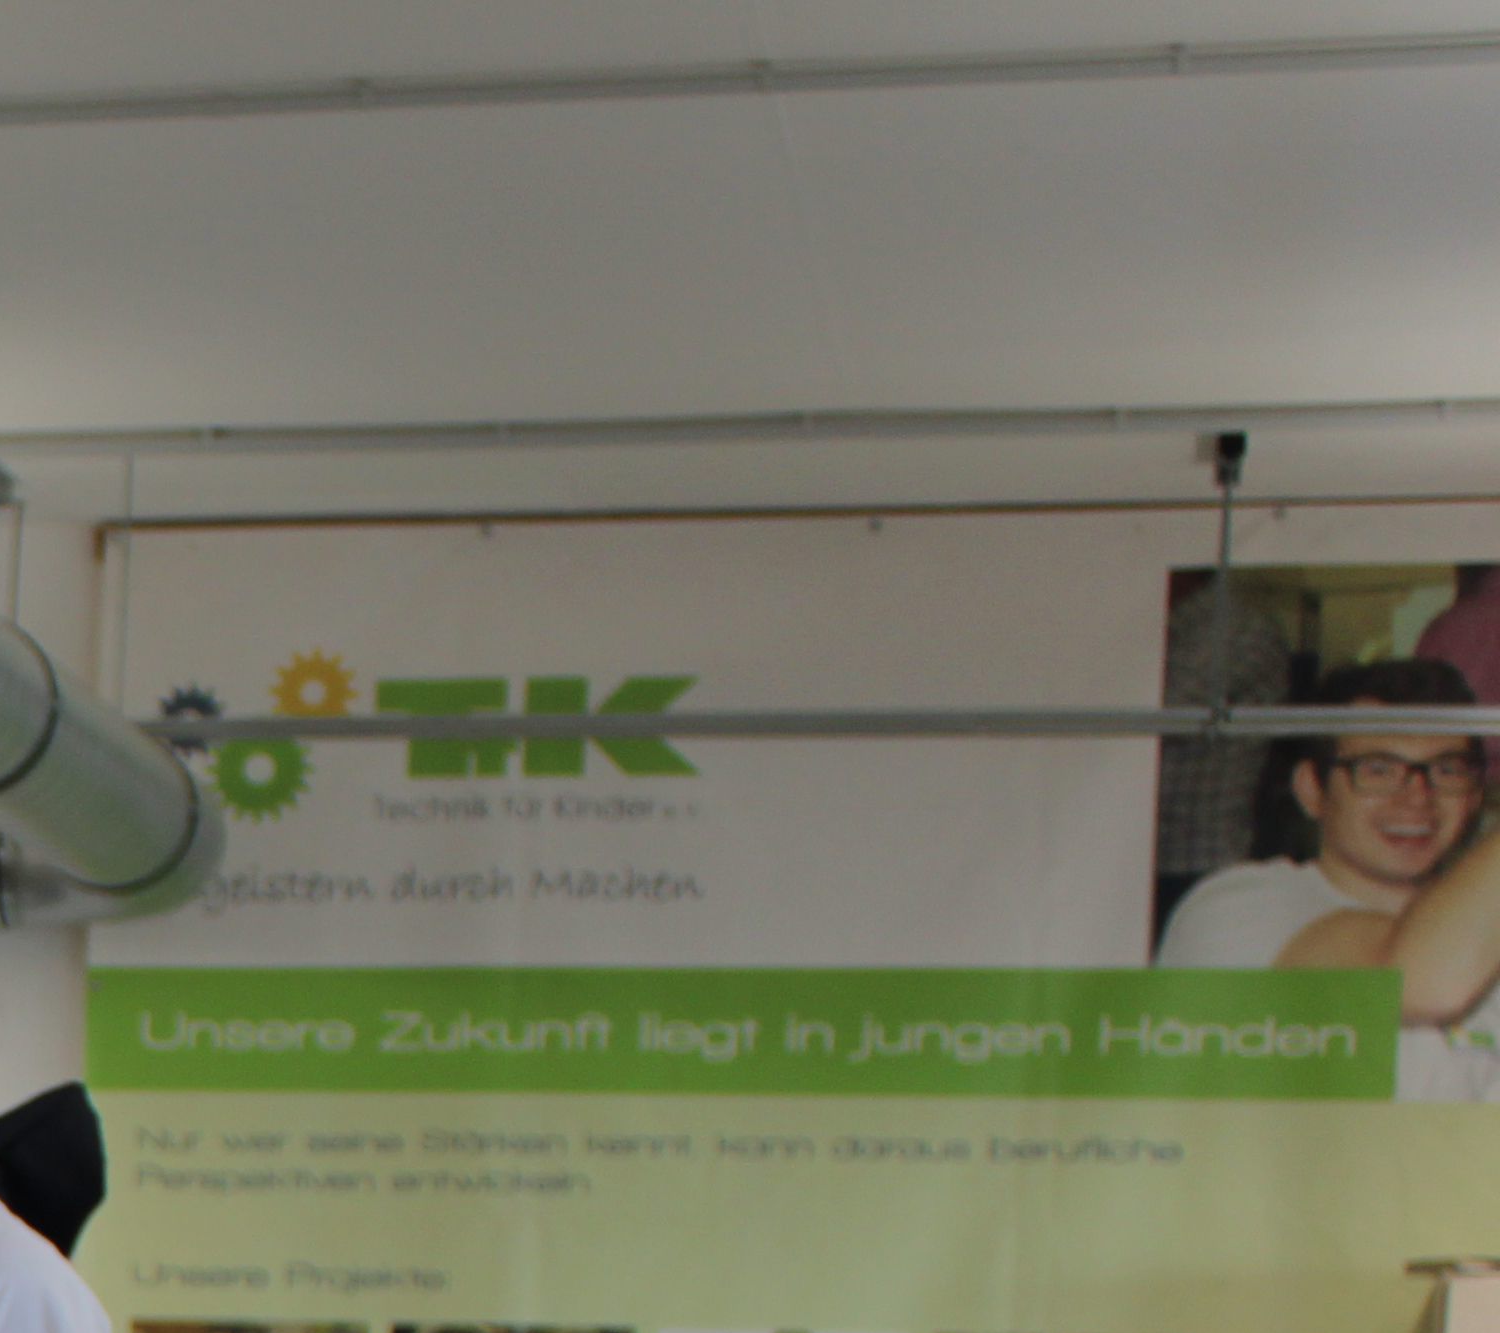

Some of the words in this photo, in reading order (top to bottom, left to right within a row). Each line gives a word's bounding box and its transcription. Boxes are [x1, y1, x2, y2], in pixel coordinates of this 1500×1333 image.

[530, 862, 706, 904] Machen
[139, 1010, 355, 1052] Unsere
[378, 1010, 610, 1053] Zukunft
[638, 1011, 757, 1062] liegt
[785, 1014, 835, 1053] in
[849, 1014, 1072, 1064] jungen
[1100, 1014, 1356, 1058] Händen
